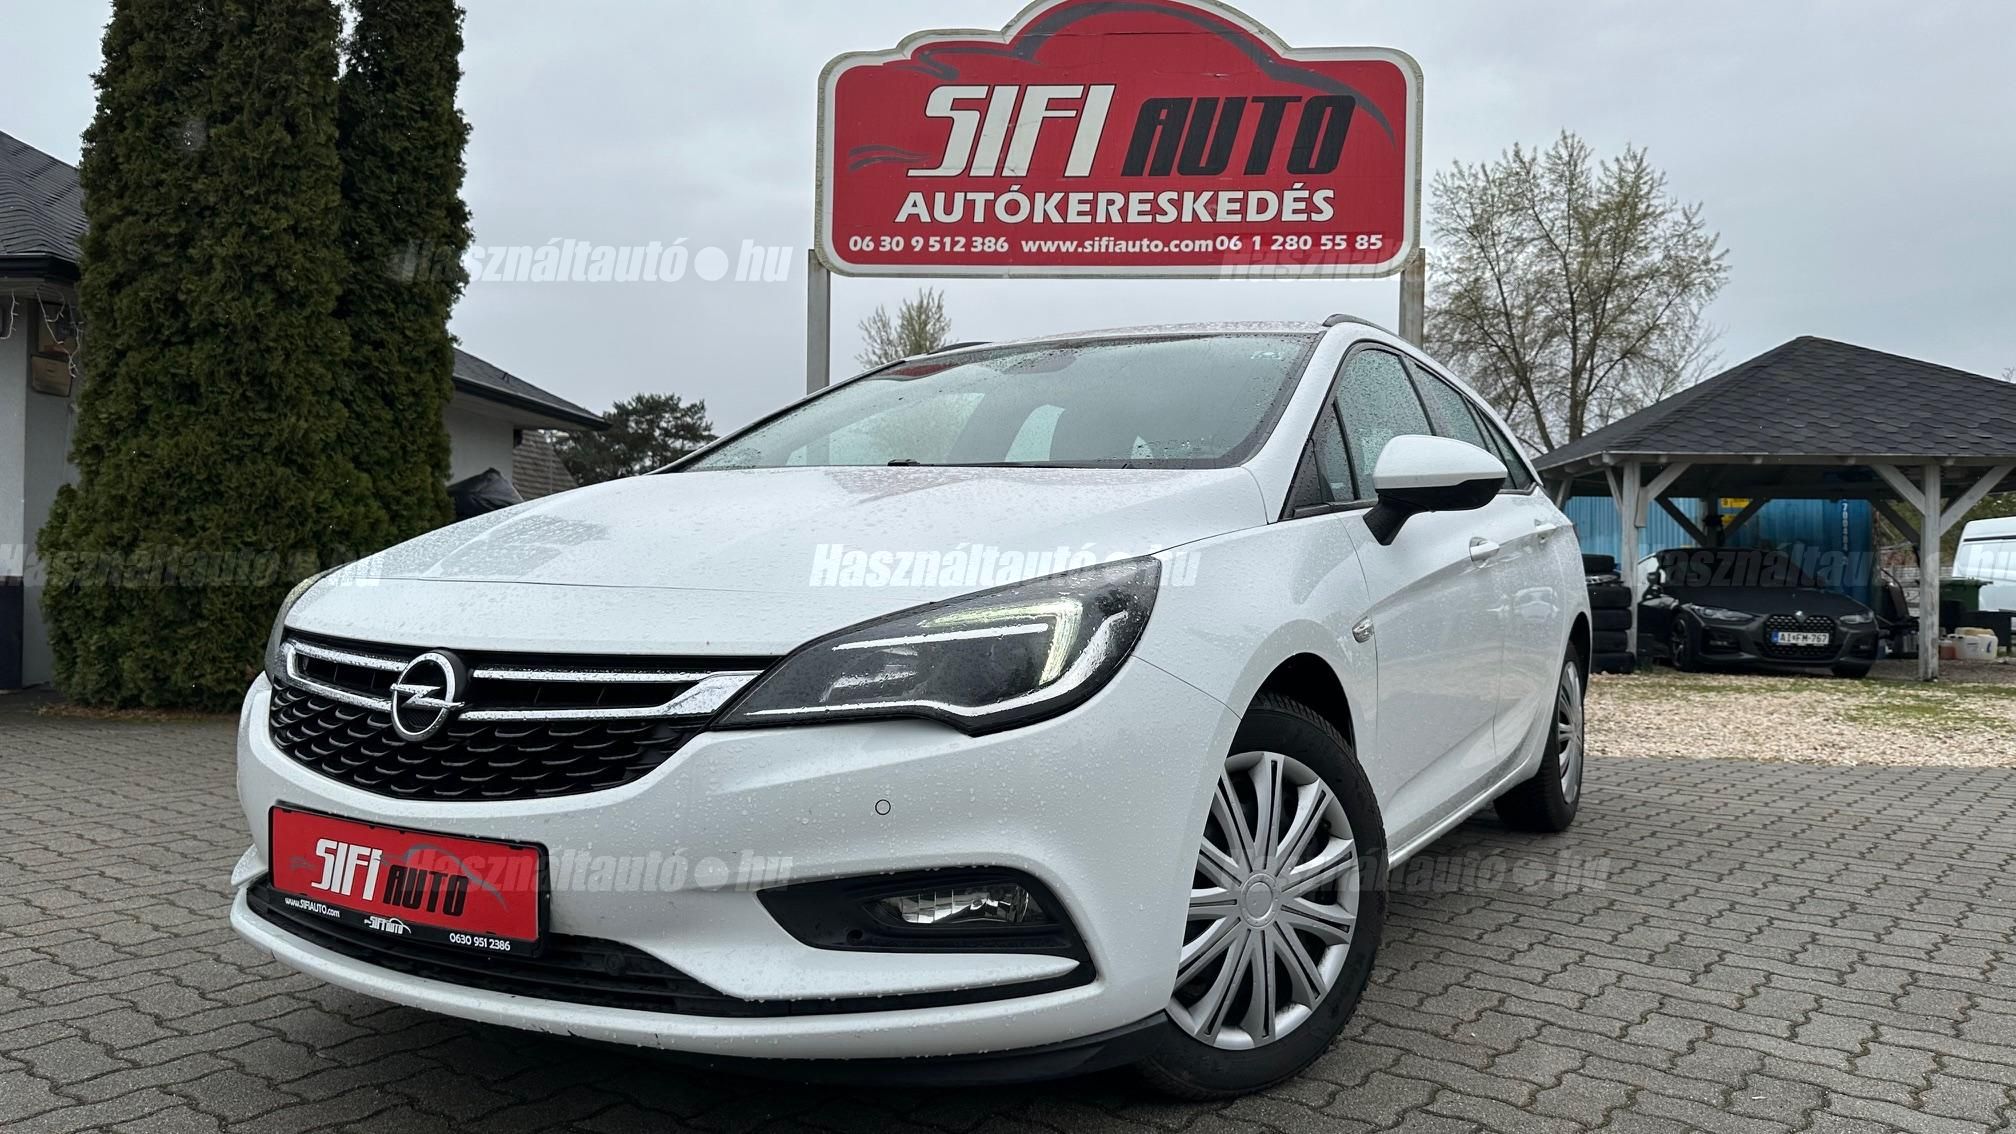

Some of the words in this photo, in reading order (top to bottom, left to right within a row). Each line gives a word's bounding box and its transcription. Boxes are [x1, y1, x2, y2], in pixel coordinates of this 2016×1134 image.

[906, 83, 1116, 178] SIFI
[1120, 94, 1357, 178] AUTO
[894, 183, 1336, 224] AUTÓKERESKEDÉS
[849, 235, 874, 251] 06
[878, 236, 904, 251] 30
[970, 236, 1009, 252] 386
[1020, 236, 1213, 252] www.sifiauto.com
[1215, 235, 1242, 250] 06
[1252, 235, 1261, 250] 1
[1270, 235, 1312, 250] 280
[1320, 235, 1347, 249] 55
[1354, 234, 1383, 249] 85
[311, 838, 382, 901] SIFI
[383, 864, 468, 917] AUTO
[284, 897, 341, 918] www.SIFIAUTO.com
[449, 932, 472, 945] 0630
[488, 938, 511, 951] 2386
